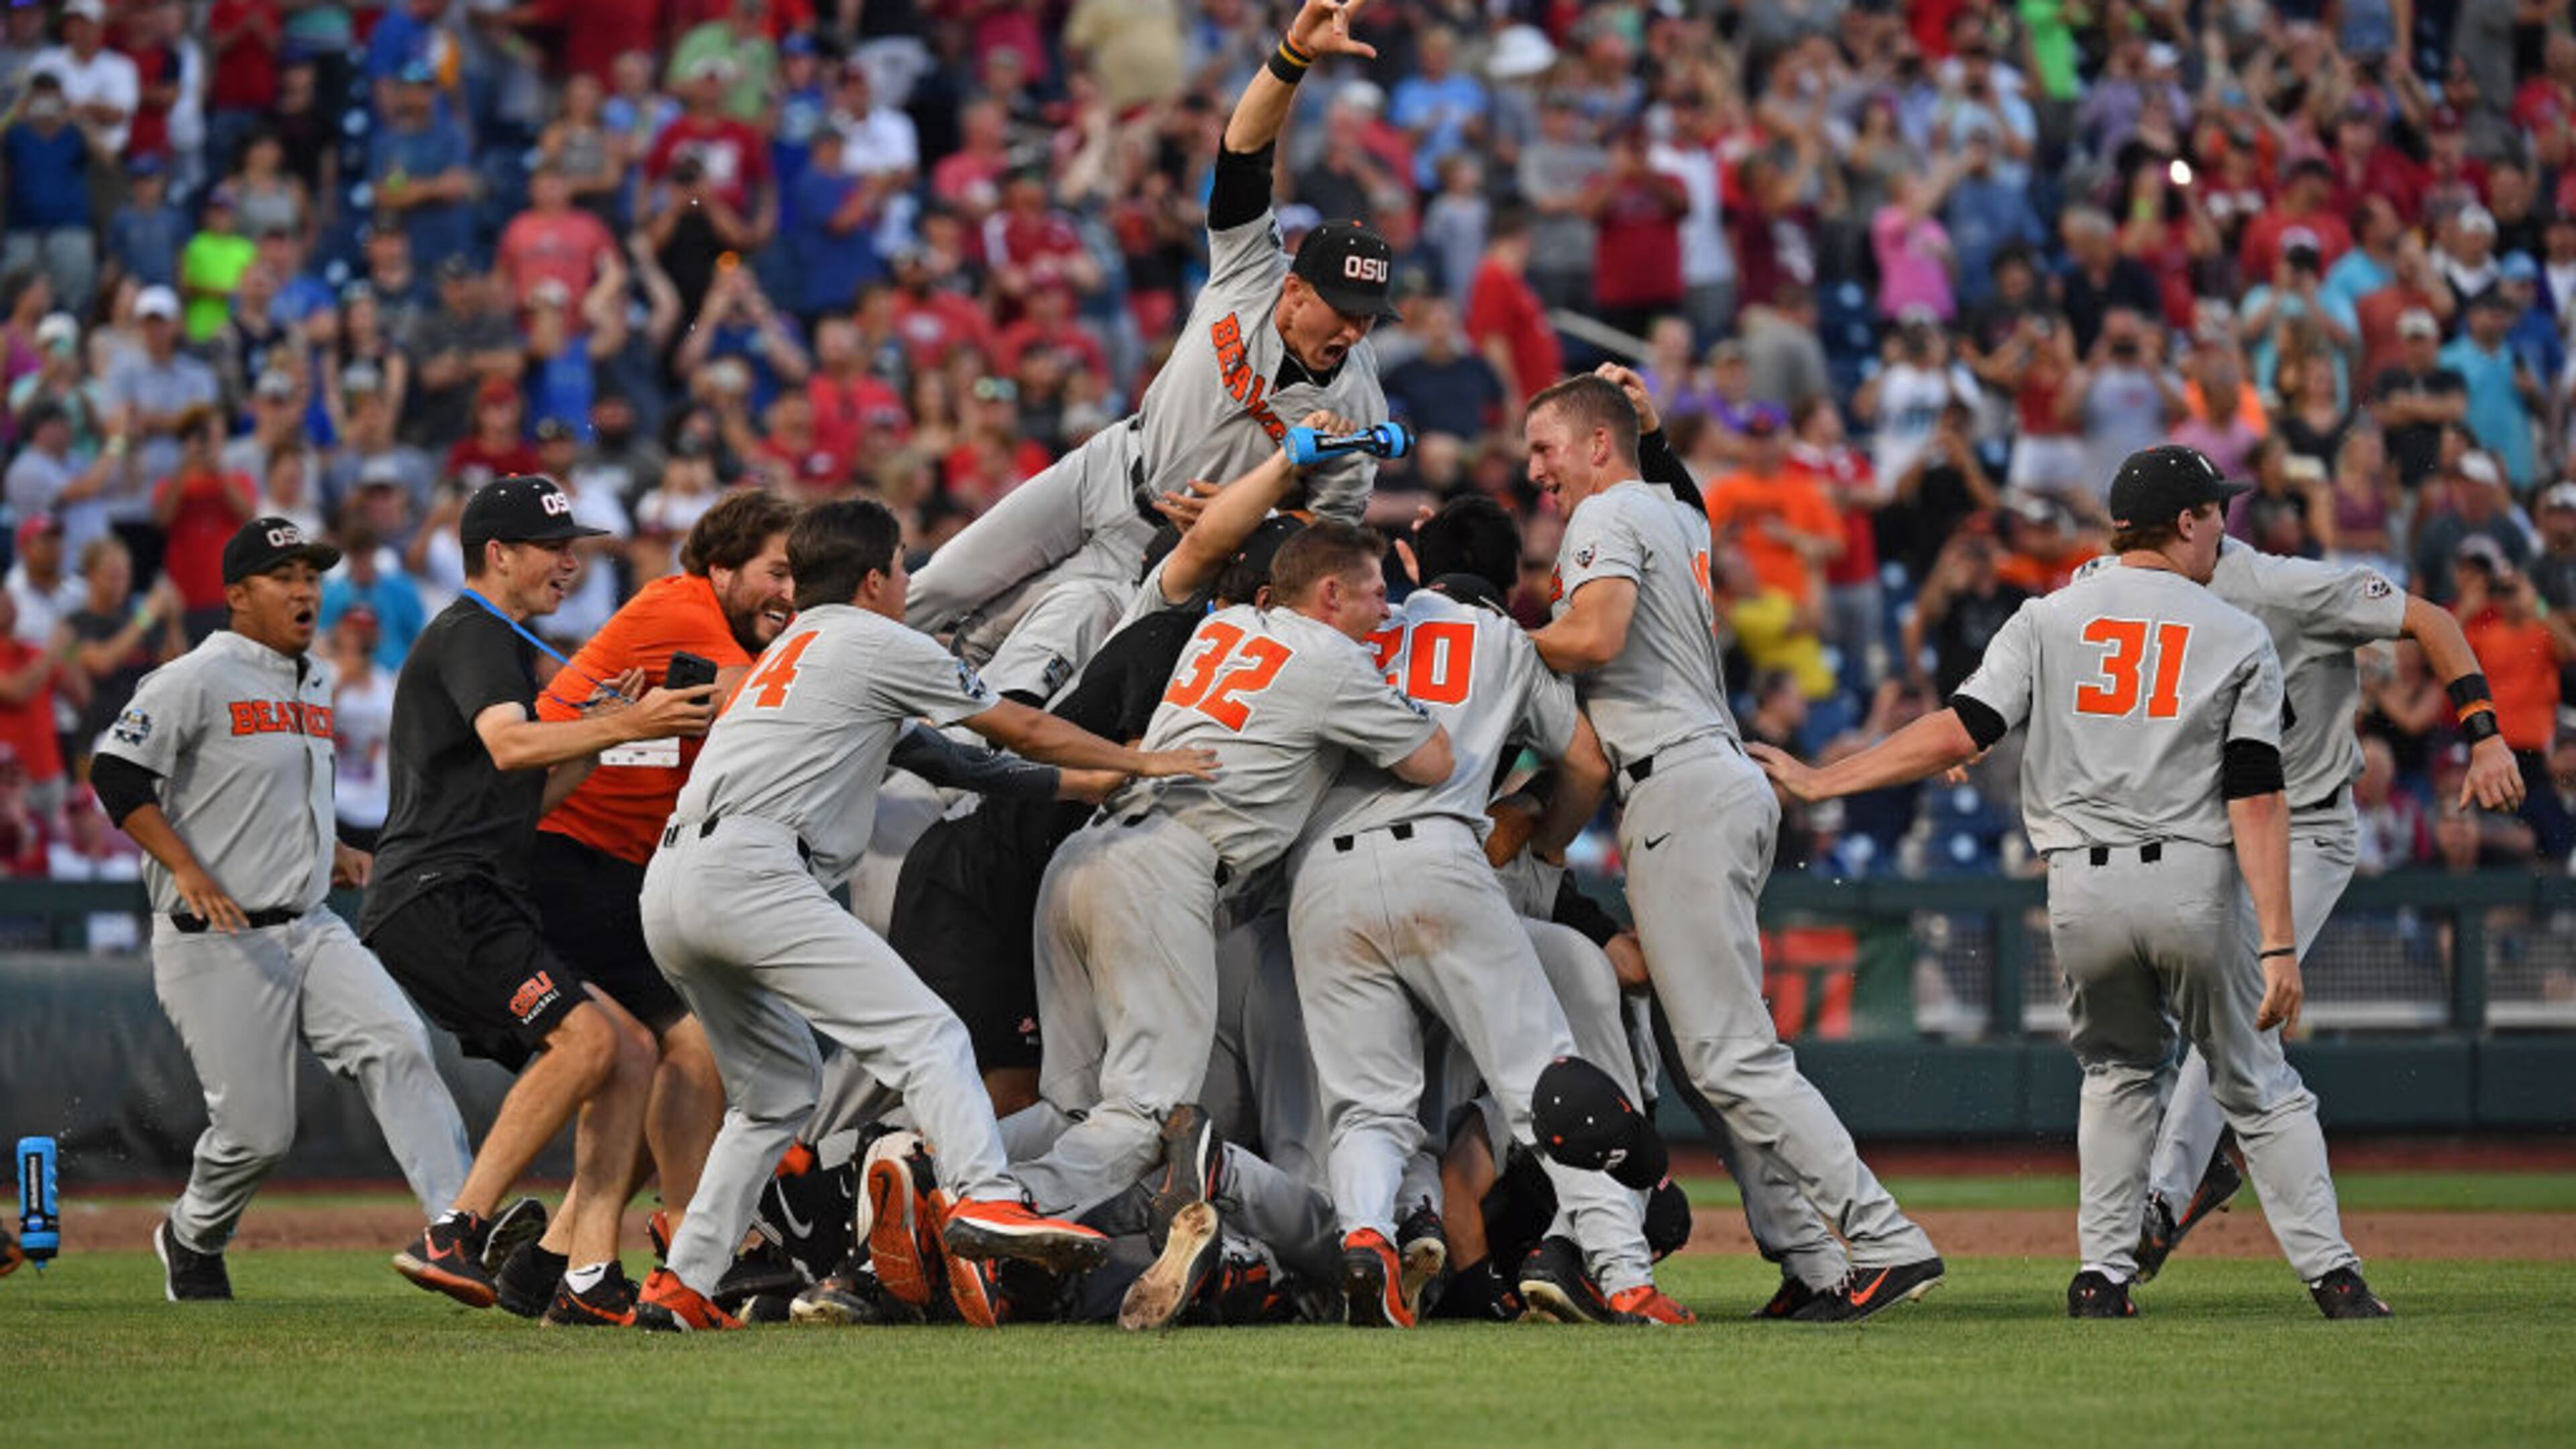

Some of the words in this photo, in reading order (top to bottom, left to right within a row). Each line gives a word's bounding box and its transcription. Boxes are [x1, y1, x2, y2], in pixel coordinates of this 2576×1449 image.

[1344, 255, 1389, 282] OSU
[540, 492, 570, 516] OS
[266, 527, 303, 547] OS
[1162, 620, 1297, 734] 32
[2073, 616, 2194, 721] 31
[510, 970, 553, 1018] OSU
